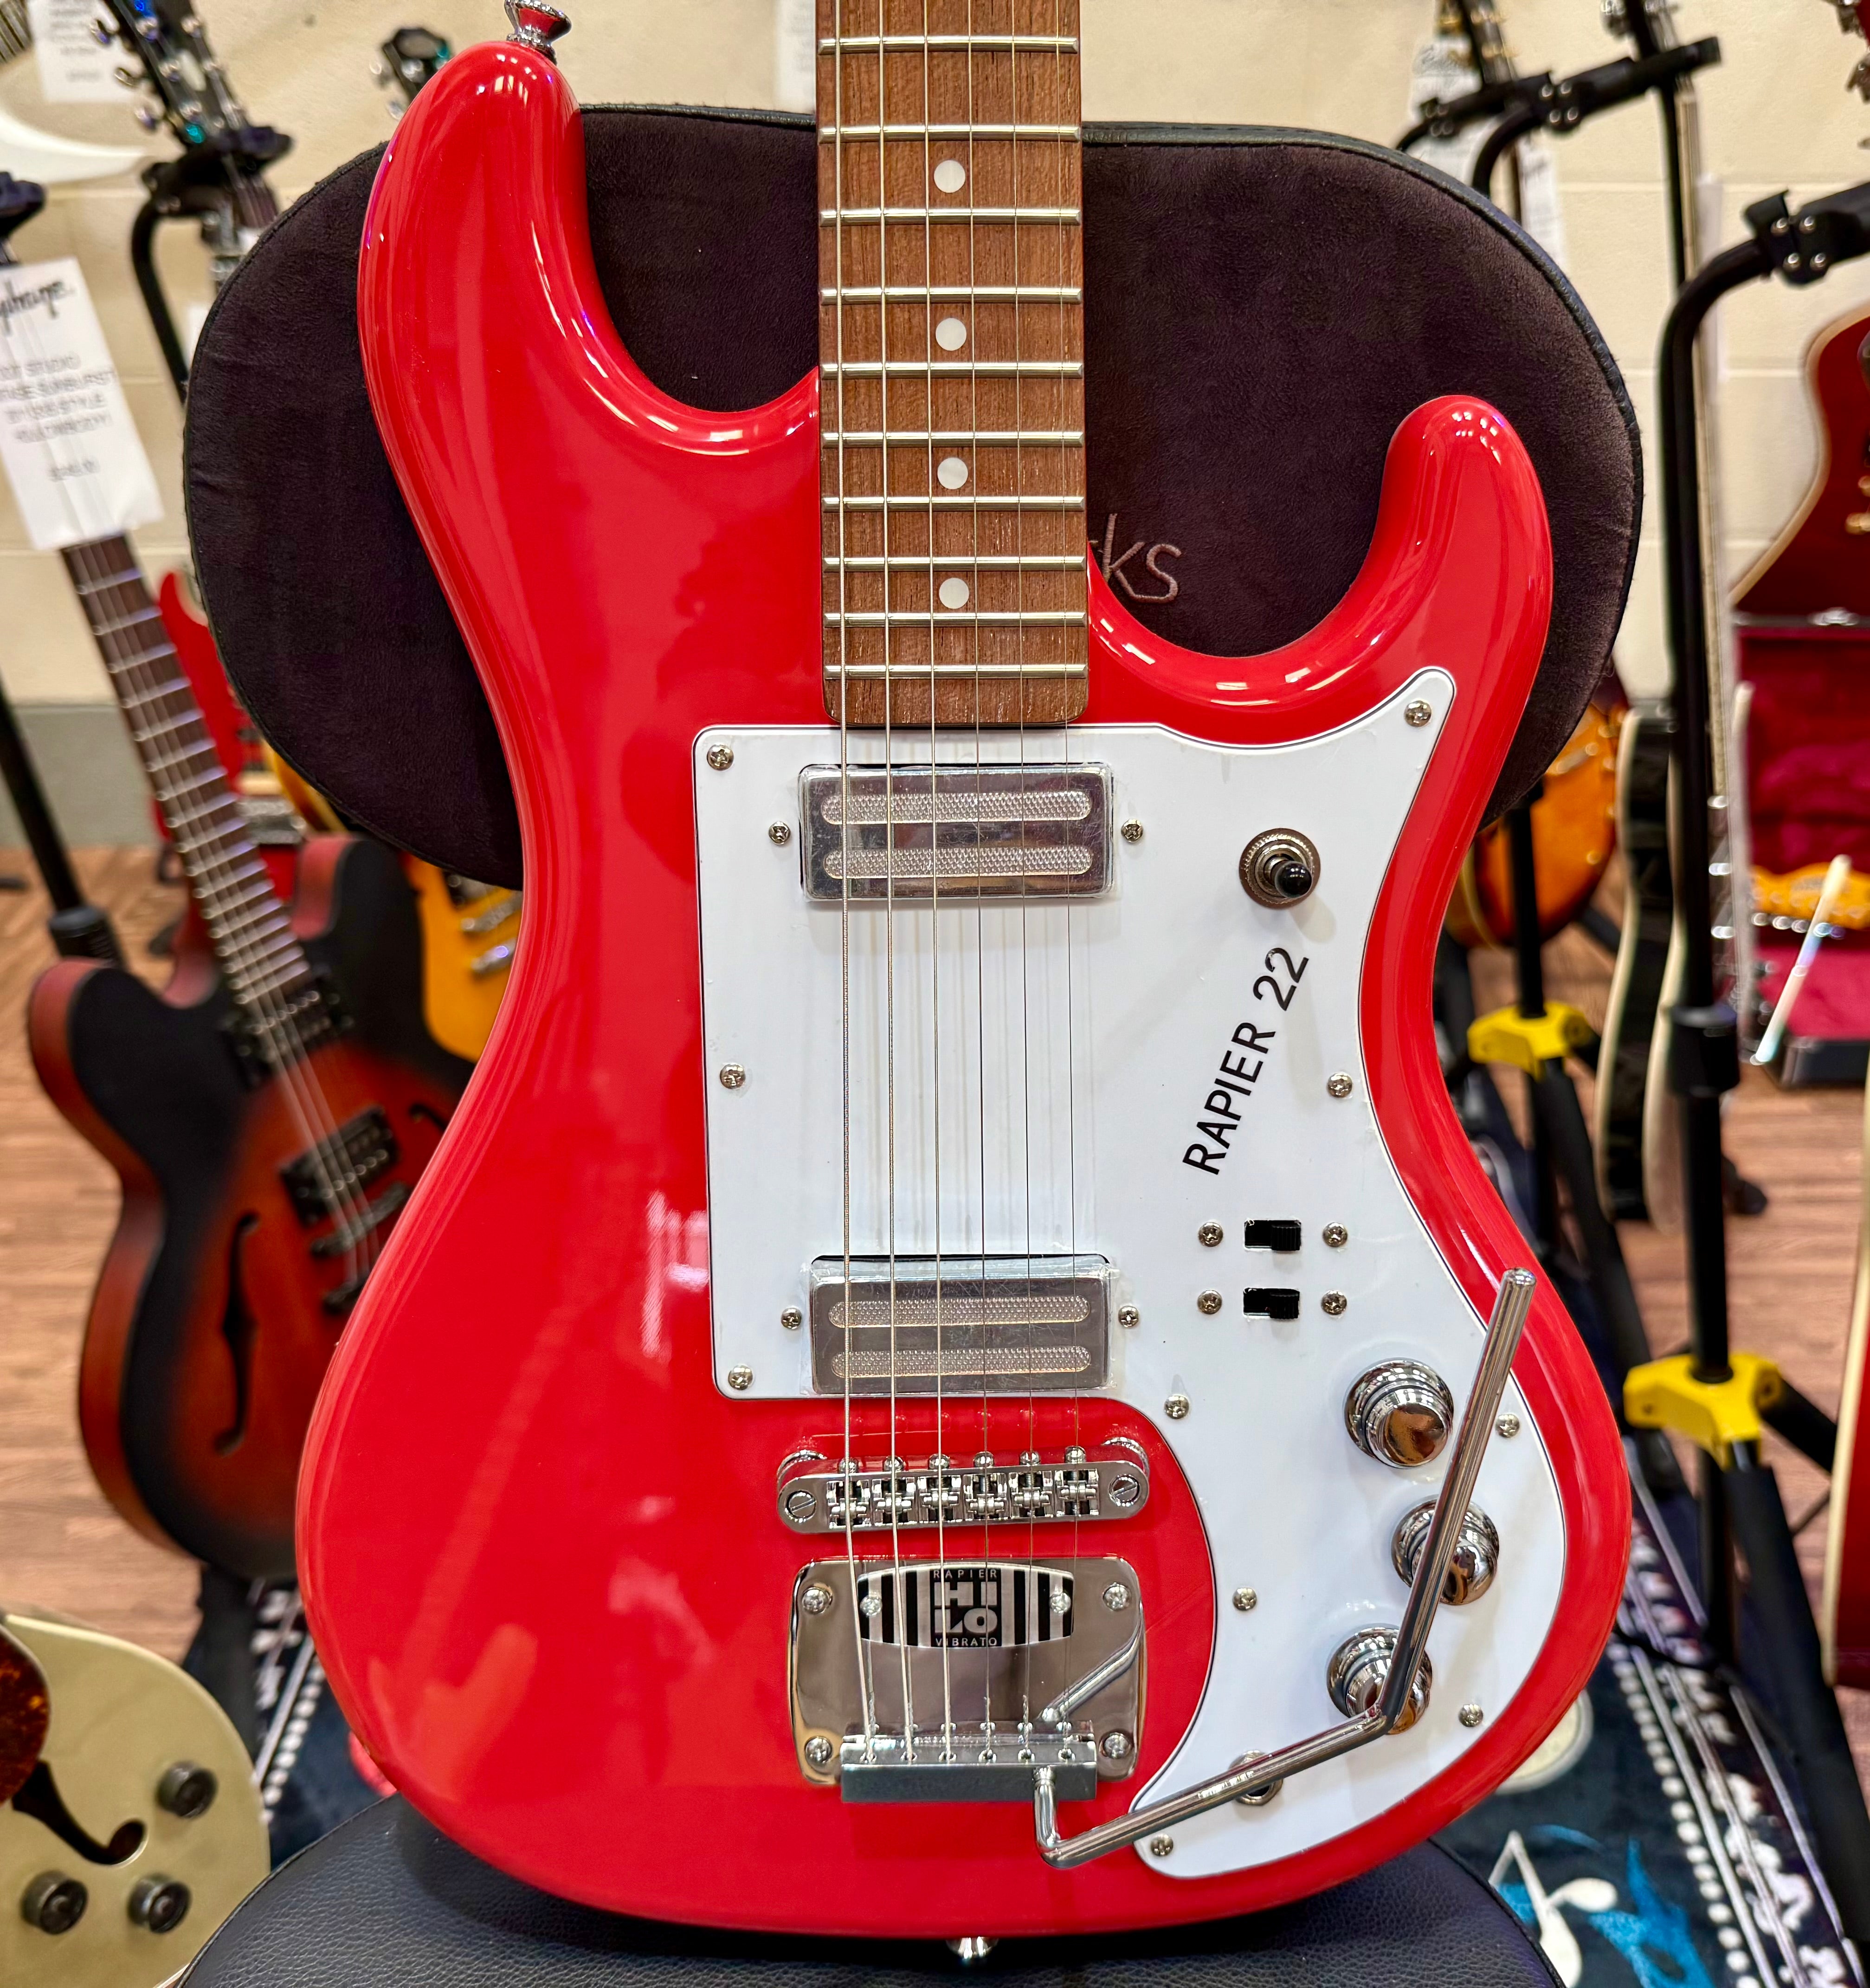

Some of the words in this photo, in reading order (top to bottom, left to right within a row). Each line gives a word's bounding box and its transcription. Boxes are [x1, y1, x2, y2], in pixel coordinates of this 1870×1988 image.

[1089, 513, 1182, 603] ks
[1182, 1022, 1276, 1175] RAPIER
[1253, 948, 1309, 1011] 22
[933, 1569, 997, 1578] RAPIER
[934, 1581, 997, 1606] HI
[935, 1607, 998, 1633] LO
[935, 1637, 997, 1646] VIBRATO
